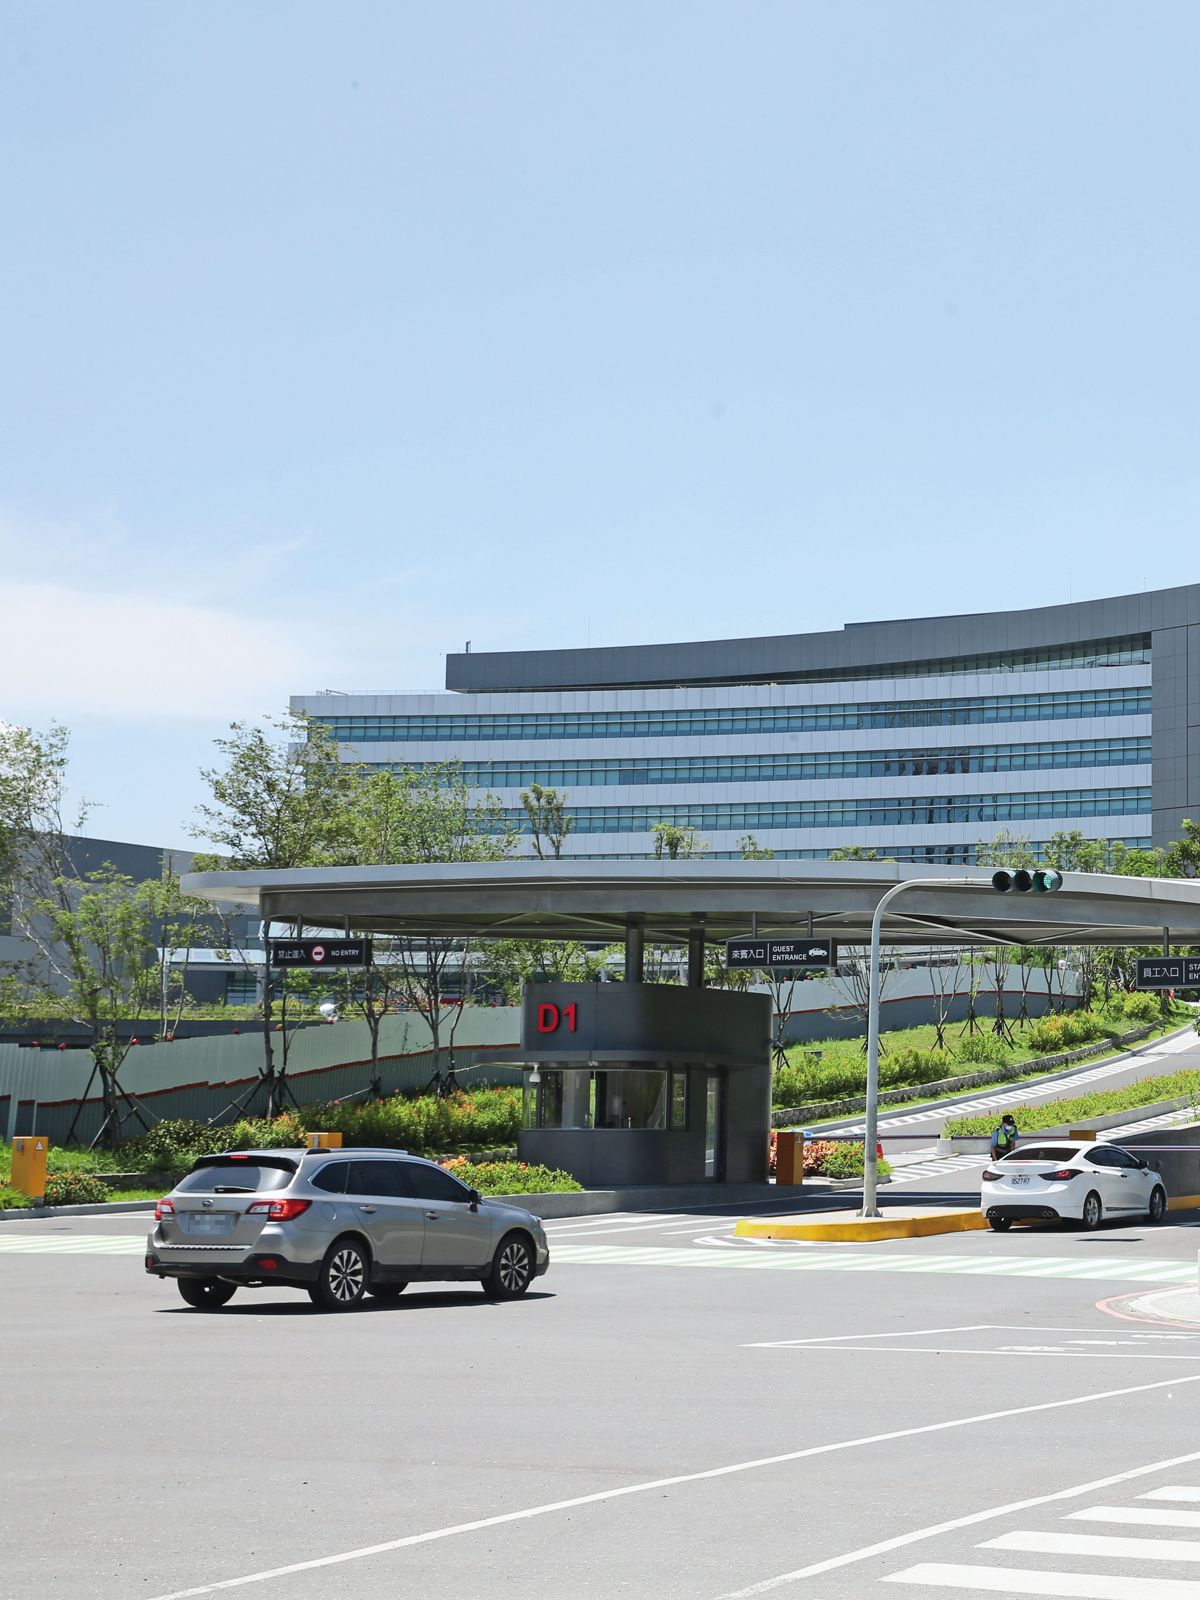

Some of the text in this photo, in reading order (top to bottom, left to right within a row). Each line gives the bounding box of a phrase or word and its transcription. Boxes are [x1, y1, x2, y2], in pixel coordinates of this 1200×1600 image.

[732, 949, 764, 959] 來賓入口
[772, 945, 795, 953] GUEST
[1143, 967, 1179, 978] 員工入口
[537, 1002, 577, 1033] D1
